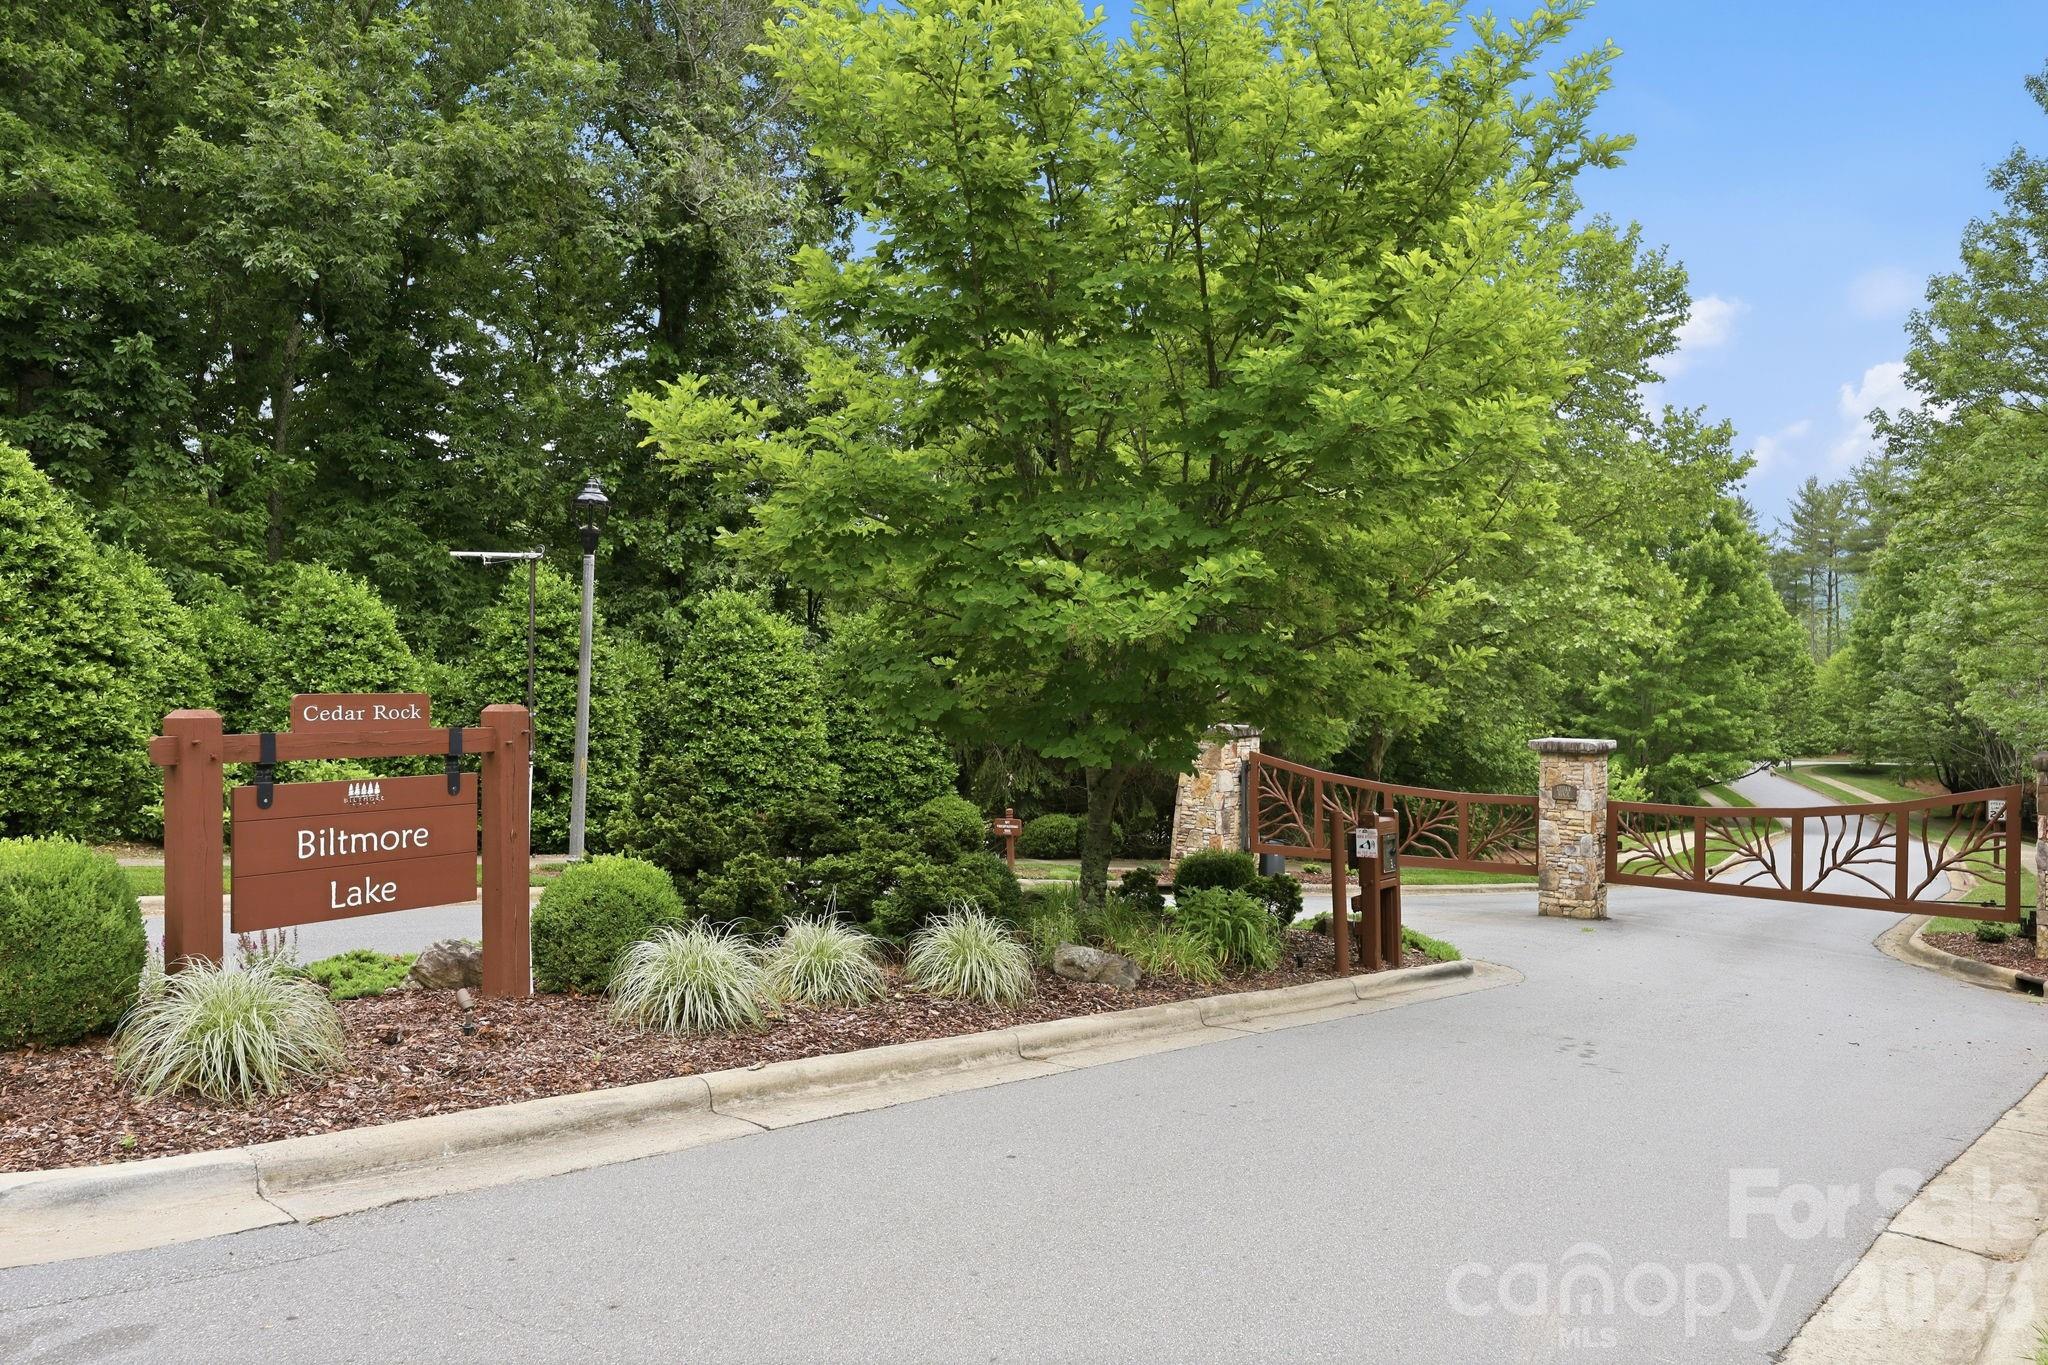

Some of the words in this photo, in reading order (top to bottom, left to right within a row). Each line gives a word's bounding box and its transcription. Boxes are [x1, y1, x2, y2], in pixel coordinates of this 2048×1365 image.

[303, 704, 366, 722] Cedar
[373, 703, 422, 720] Rock
[297, 827, 429, 860] Biltmore
[330, 876, 397, 909] Lake
